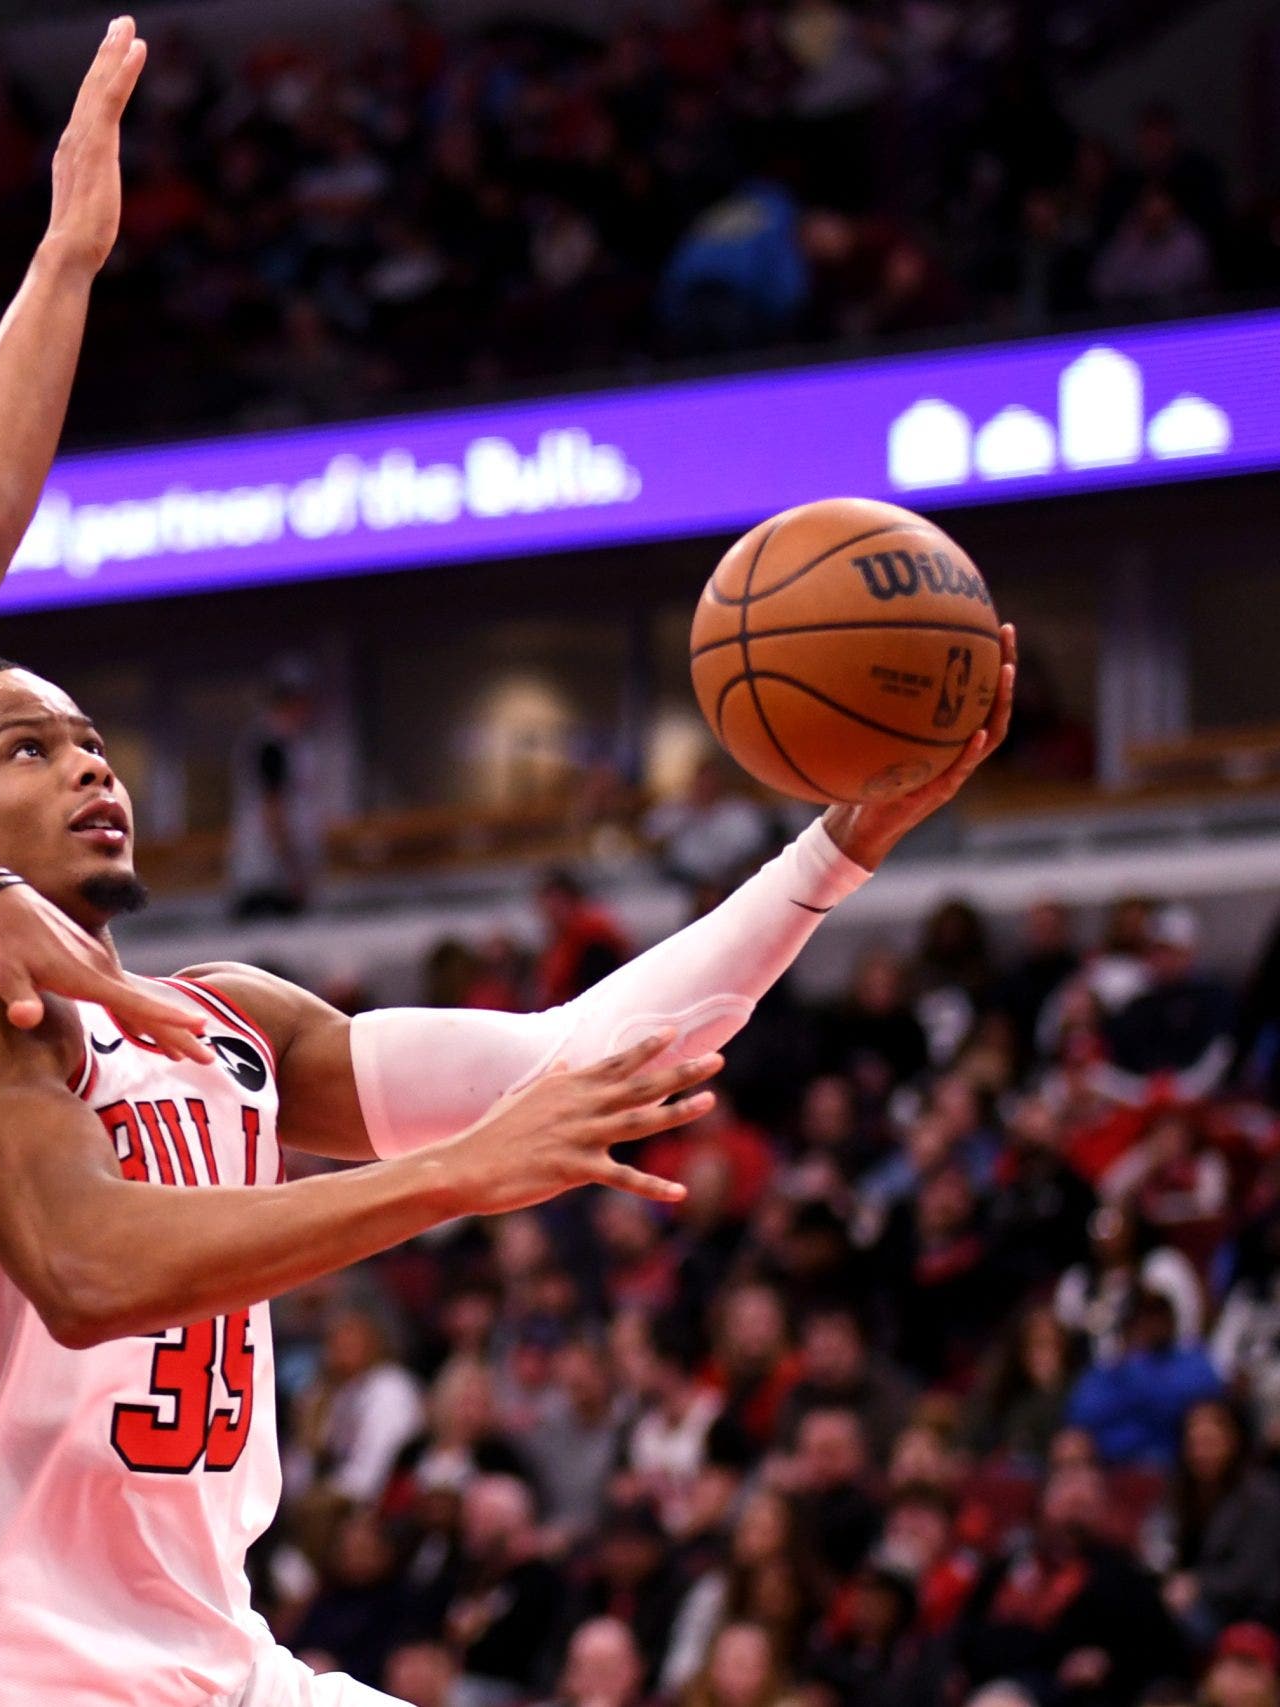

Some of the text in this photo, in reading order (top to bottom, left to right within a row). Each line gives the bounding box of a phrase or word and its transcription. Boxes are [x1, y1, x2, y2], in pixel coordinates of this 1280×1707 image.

[67, 484, 284, 578] partner
[287, 453, 361, 539] of
[360, 449, 462, 531] the
